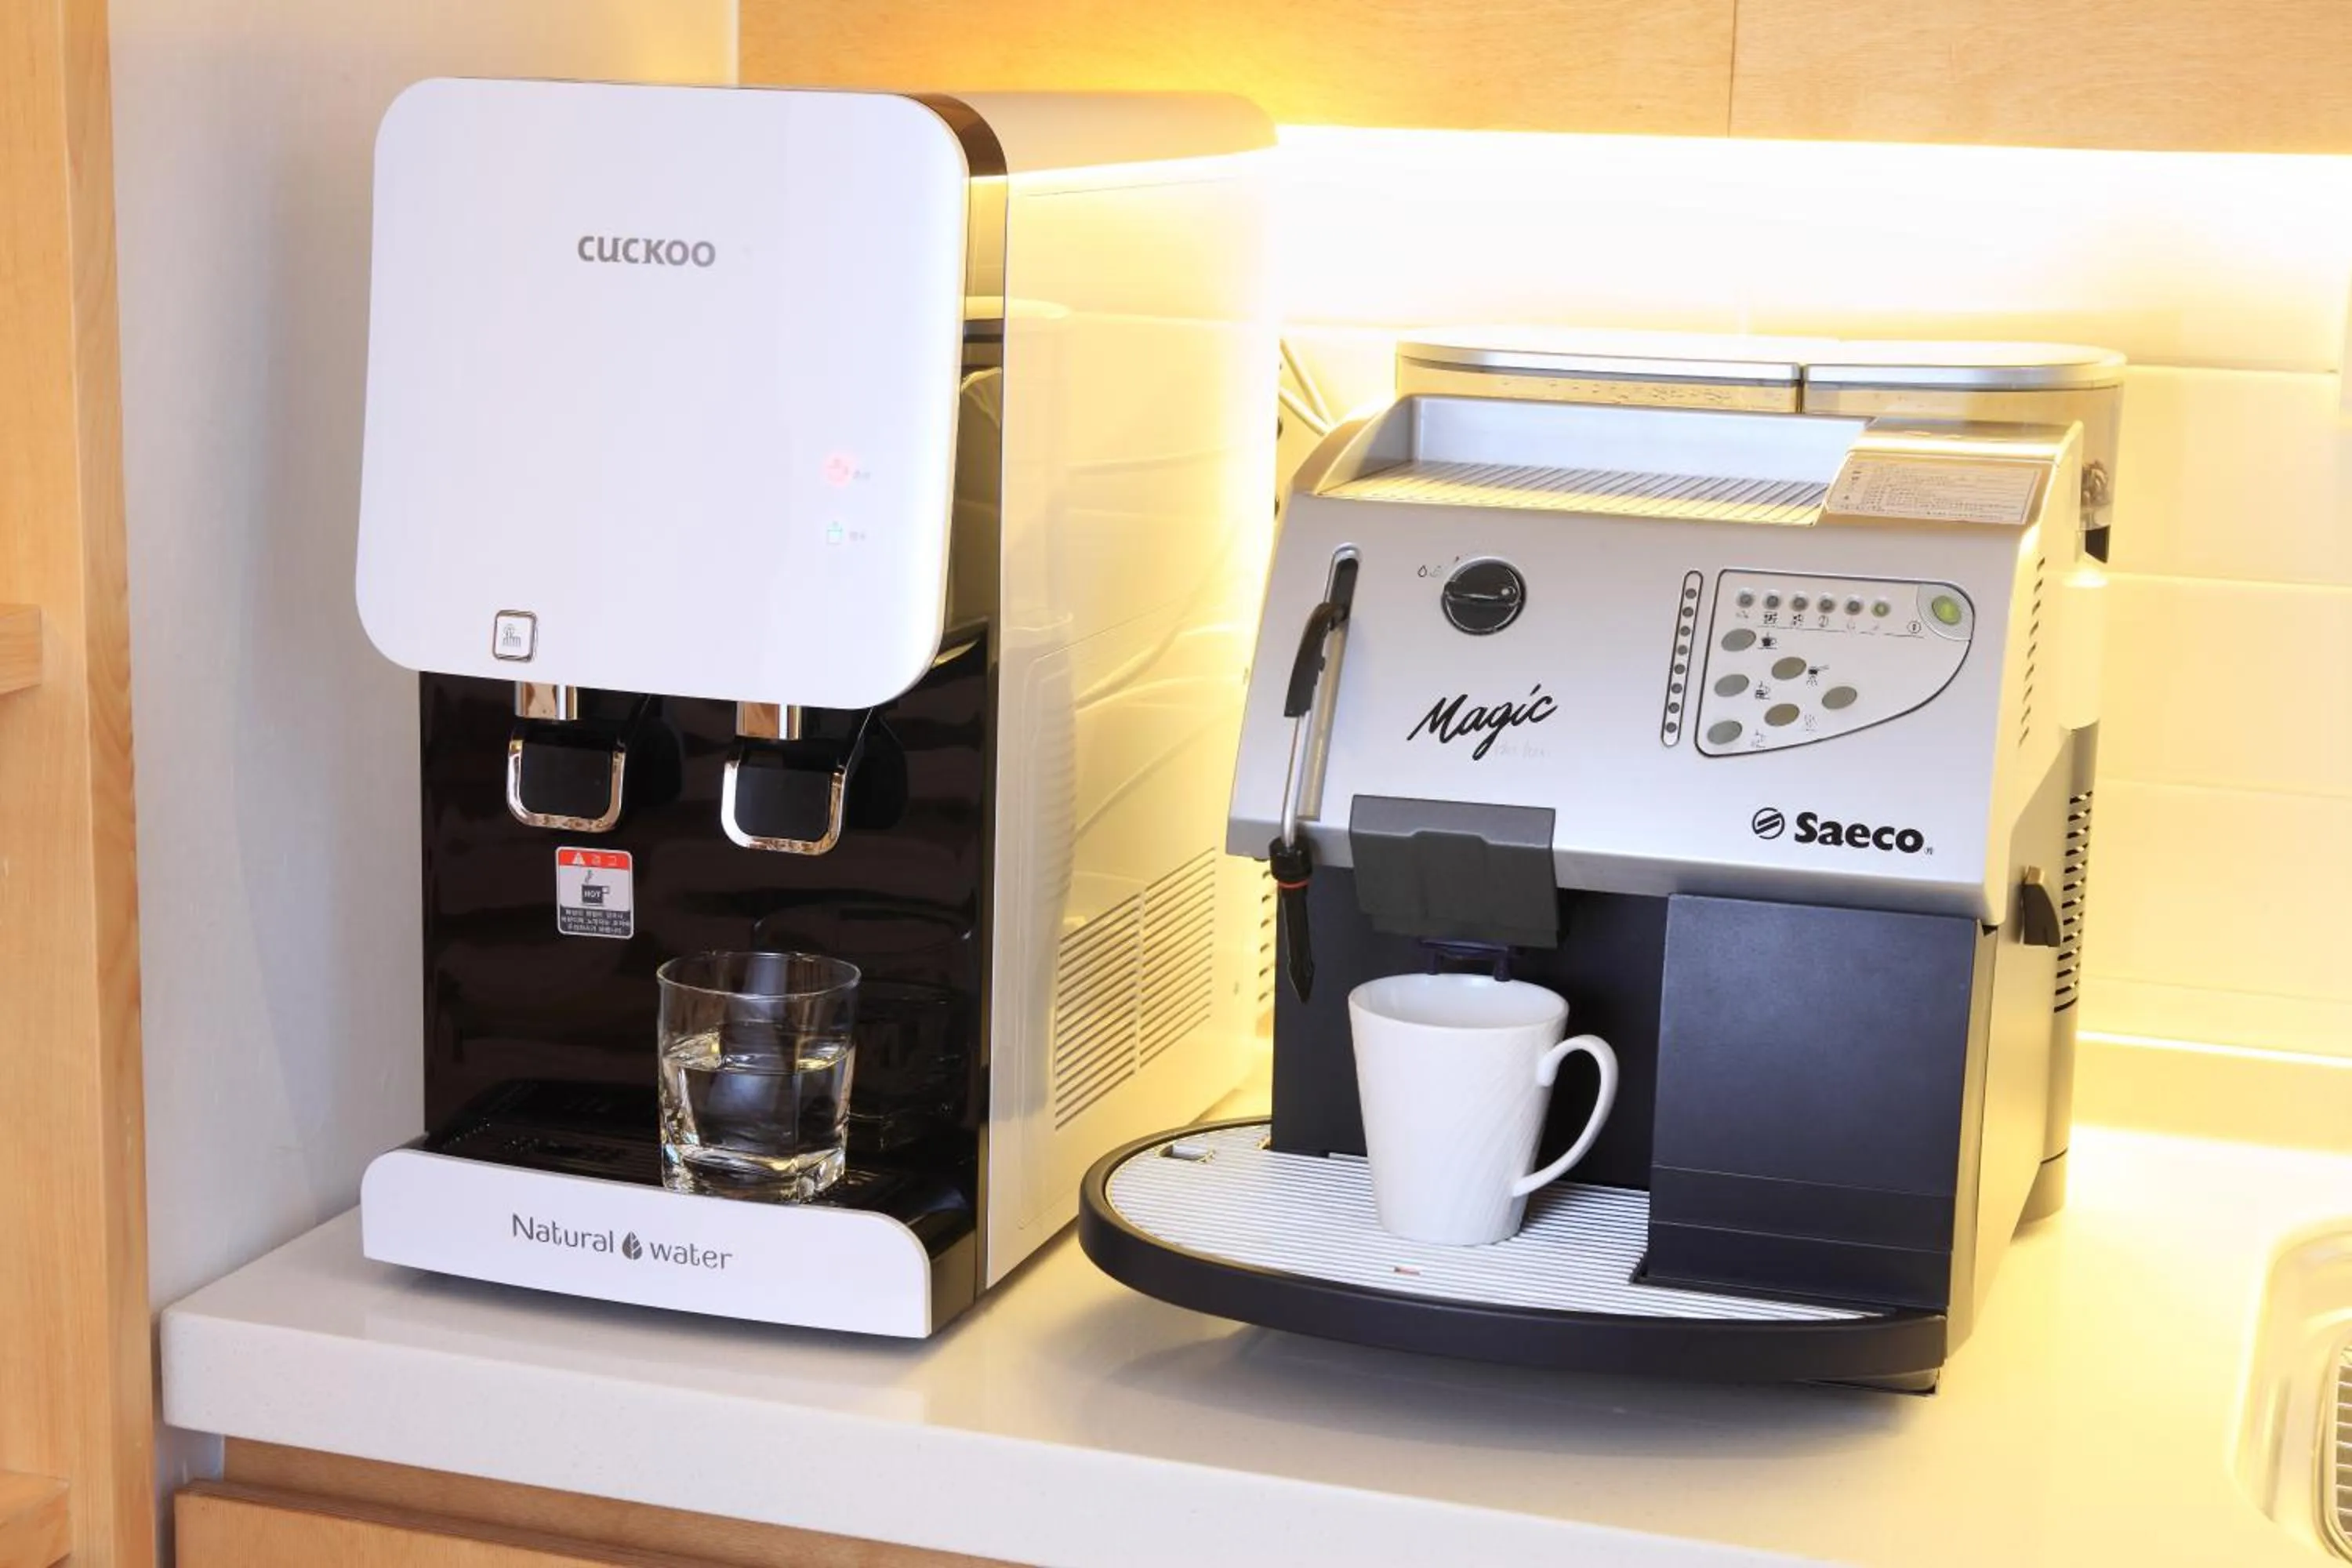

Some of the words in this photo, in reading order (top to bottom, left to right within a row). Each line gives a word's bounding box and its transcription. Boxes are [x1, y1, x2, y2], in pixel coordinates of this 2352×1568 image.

[577, 235, 716, 267] CUCKOO
[1406, 683, 1559, 760] Magic
[1794, 811, 1925, 854] Saeco
[512, 1213, 614, 1253] Natural
[650, 1242, 732, 1269] water
